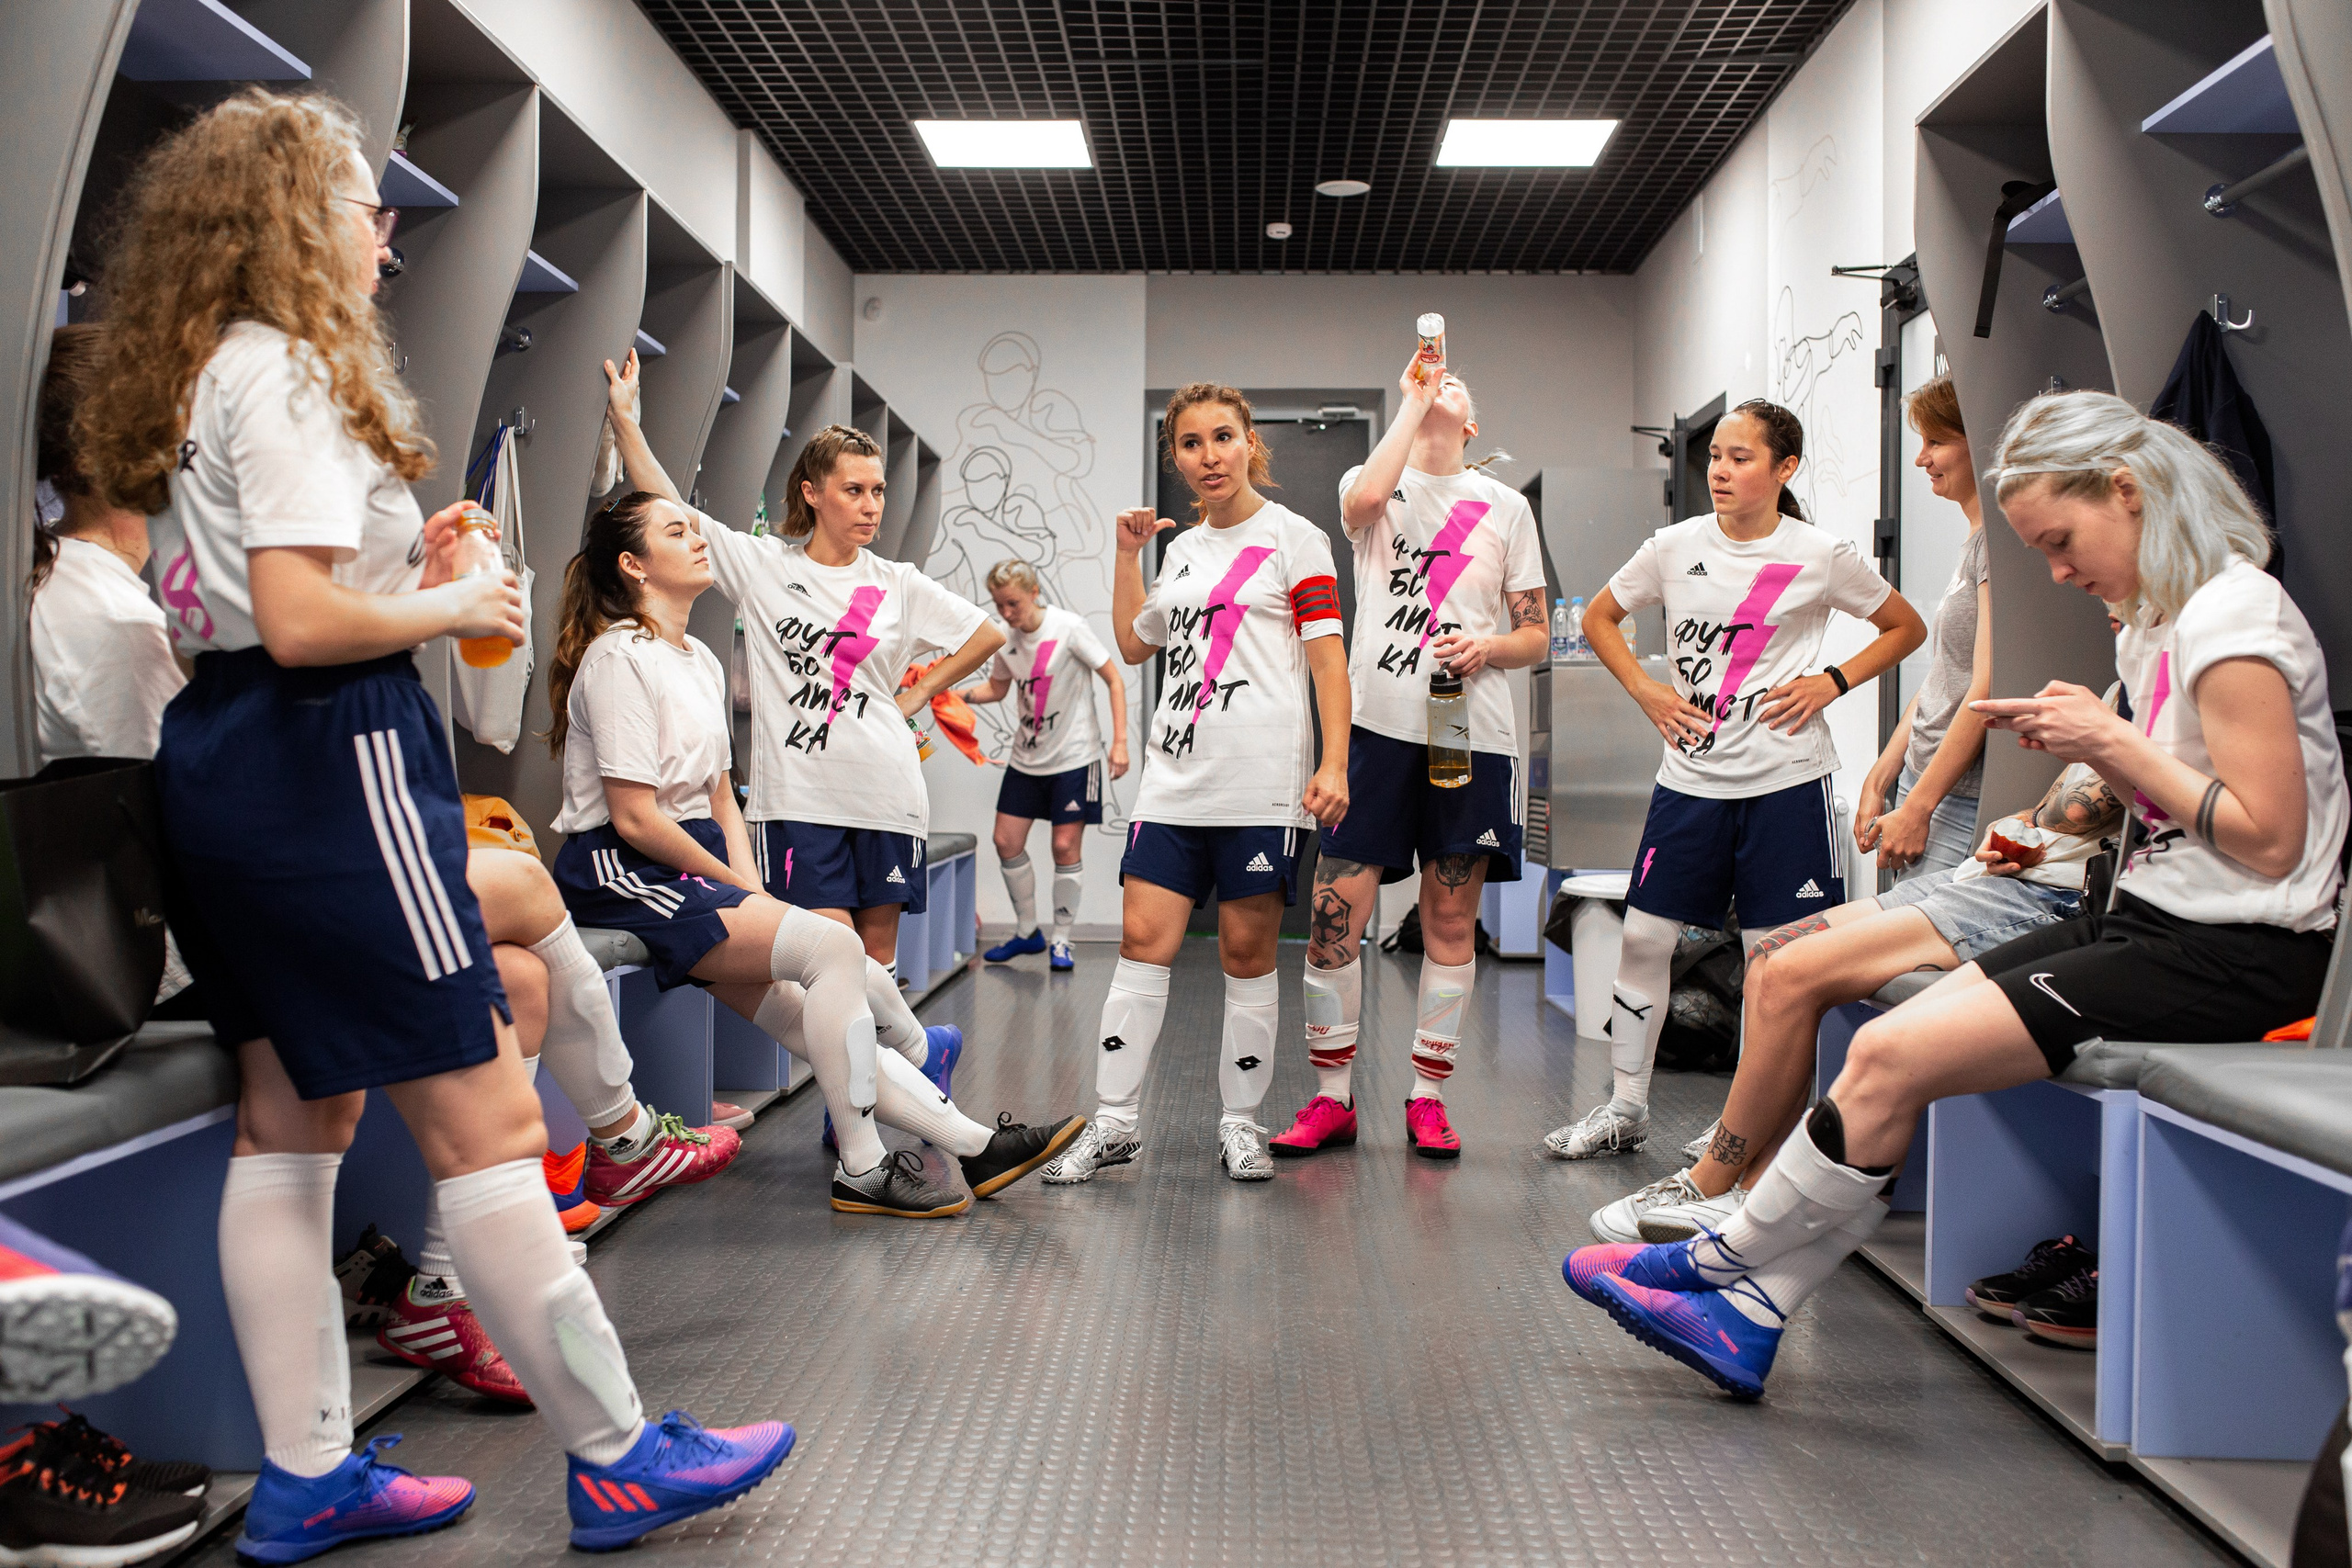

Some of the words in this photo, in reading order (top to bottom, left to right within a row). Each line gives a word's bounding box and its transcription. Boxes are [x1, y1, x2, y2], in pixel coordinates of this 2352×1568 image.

[775, 616, 858, 659] ФУТ
[1674, 617, 1755, 656] ФУТ
[783, 649, 820, 676] БО
[1167, 644, 1196, 678] БО
[1377, 643, 1421, 678] КА
[1675, 656, 1712, 686] БО
[1017, 676, 1041, 695] УТ
[1169, 678, 1250, 712] ЛИСТ
[785, 719, 830, 755] КА
[1161, 722, 1195, 760] КА
